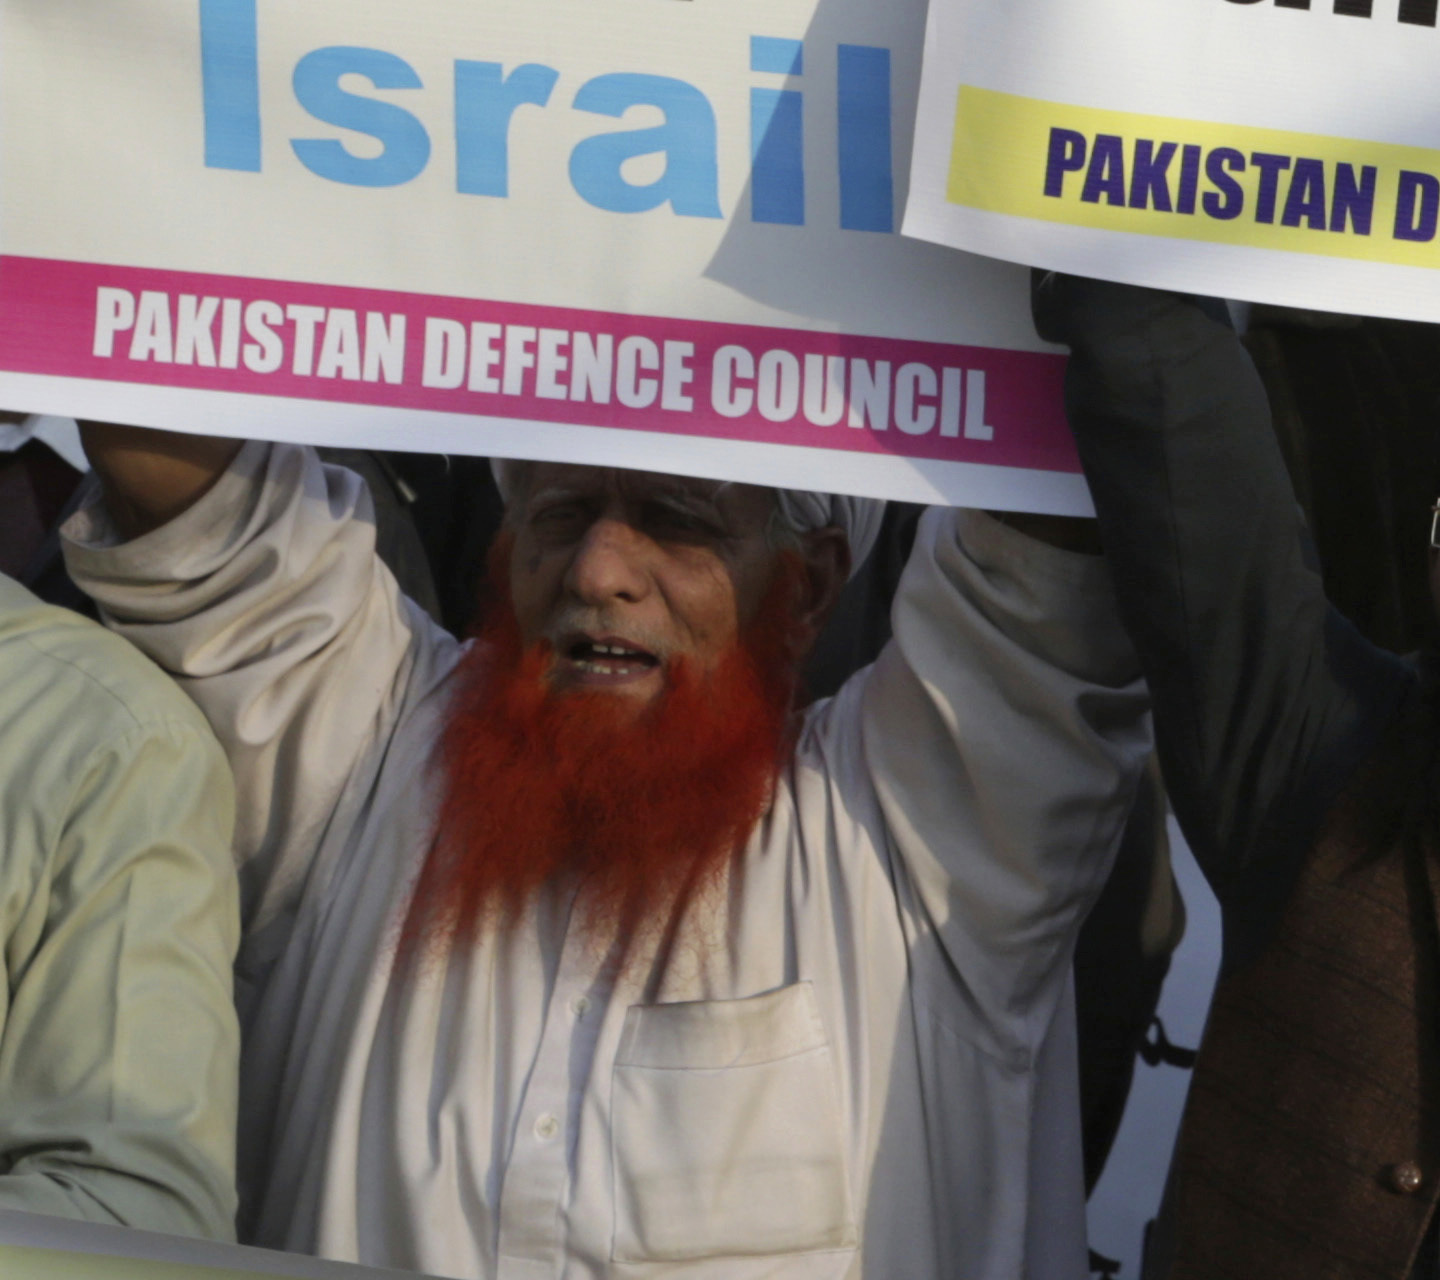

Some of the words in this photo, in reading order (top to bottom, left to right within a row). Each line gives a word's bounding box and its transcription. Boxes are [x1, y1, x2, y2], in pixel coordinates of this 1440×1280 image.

[1040, 122, 1379, 236] PAKISTAN
[89, 282, 410, 388] PAKISTAN
[419, 314, 696, 415] DEFENCE
[708, 345, 997, 444] COUNCIL
